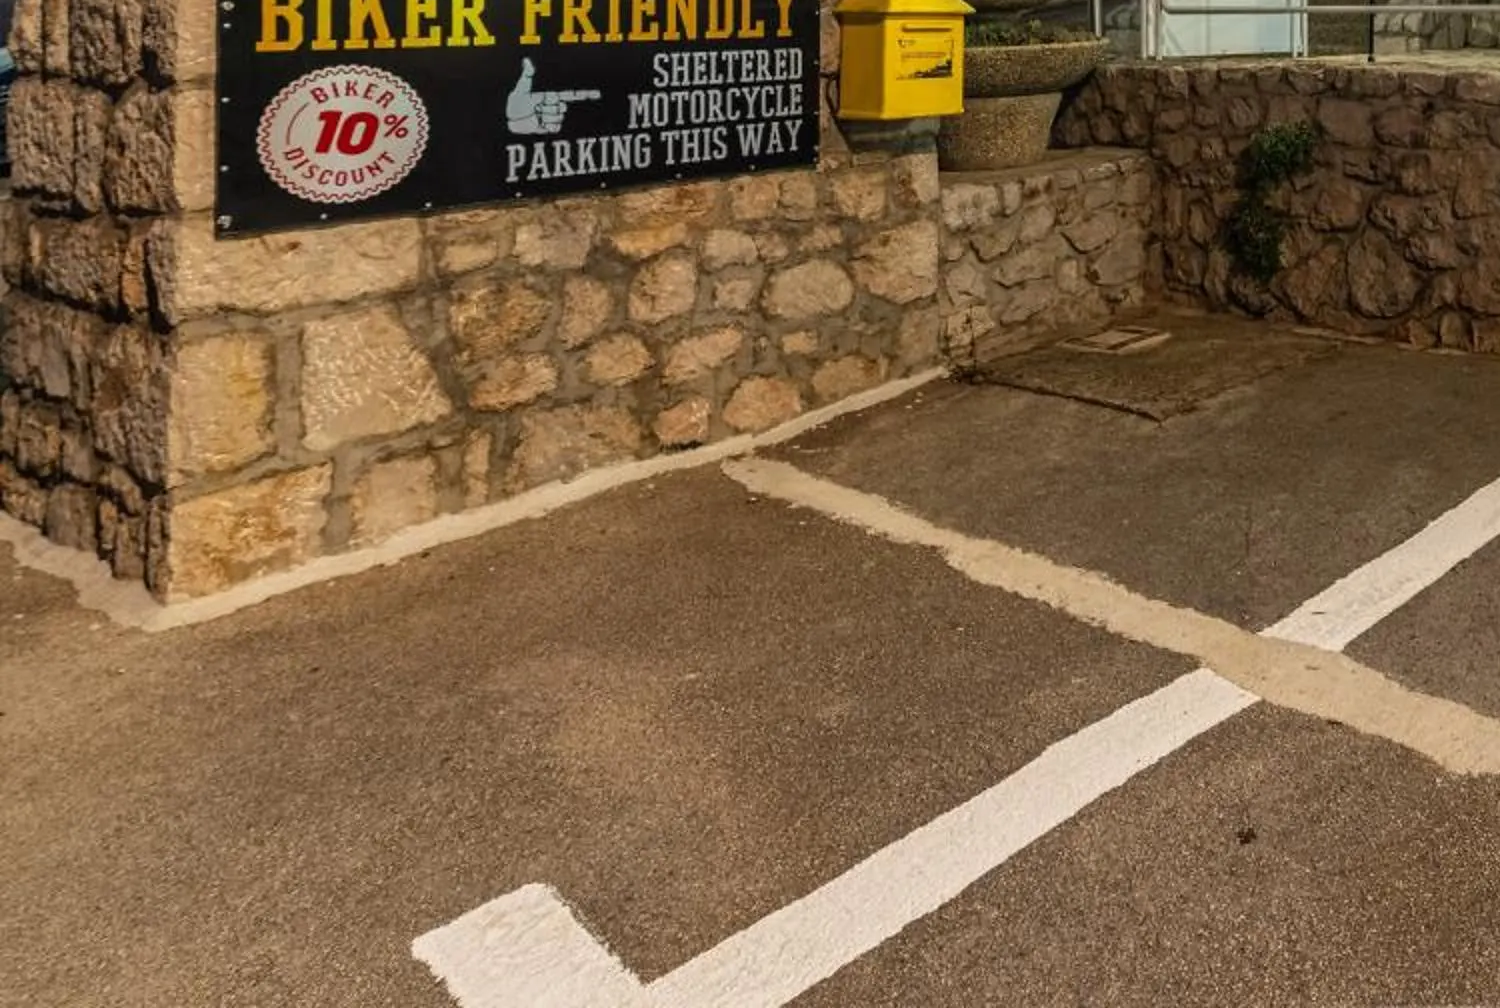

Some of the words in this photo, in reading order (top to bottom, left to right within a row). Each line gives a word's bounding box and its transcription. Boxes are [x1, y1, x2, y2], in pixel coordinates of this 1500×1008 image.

[653, 47, 803, 87] SHELTERED
[310, 81, 396, 108] BIKER
[628, 84, 803, 130] MOTORCYCLE
[283, 146, 396, 187] DISCOUNT
[505, 134, 652, 183] PARKING
[660, 127, 728, 165] THIS
[736, 119, 803, 157] WAY
